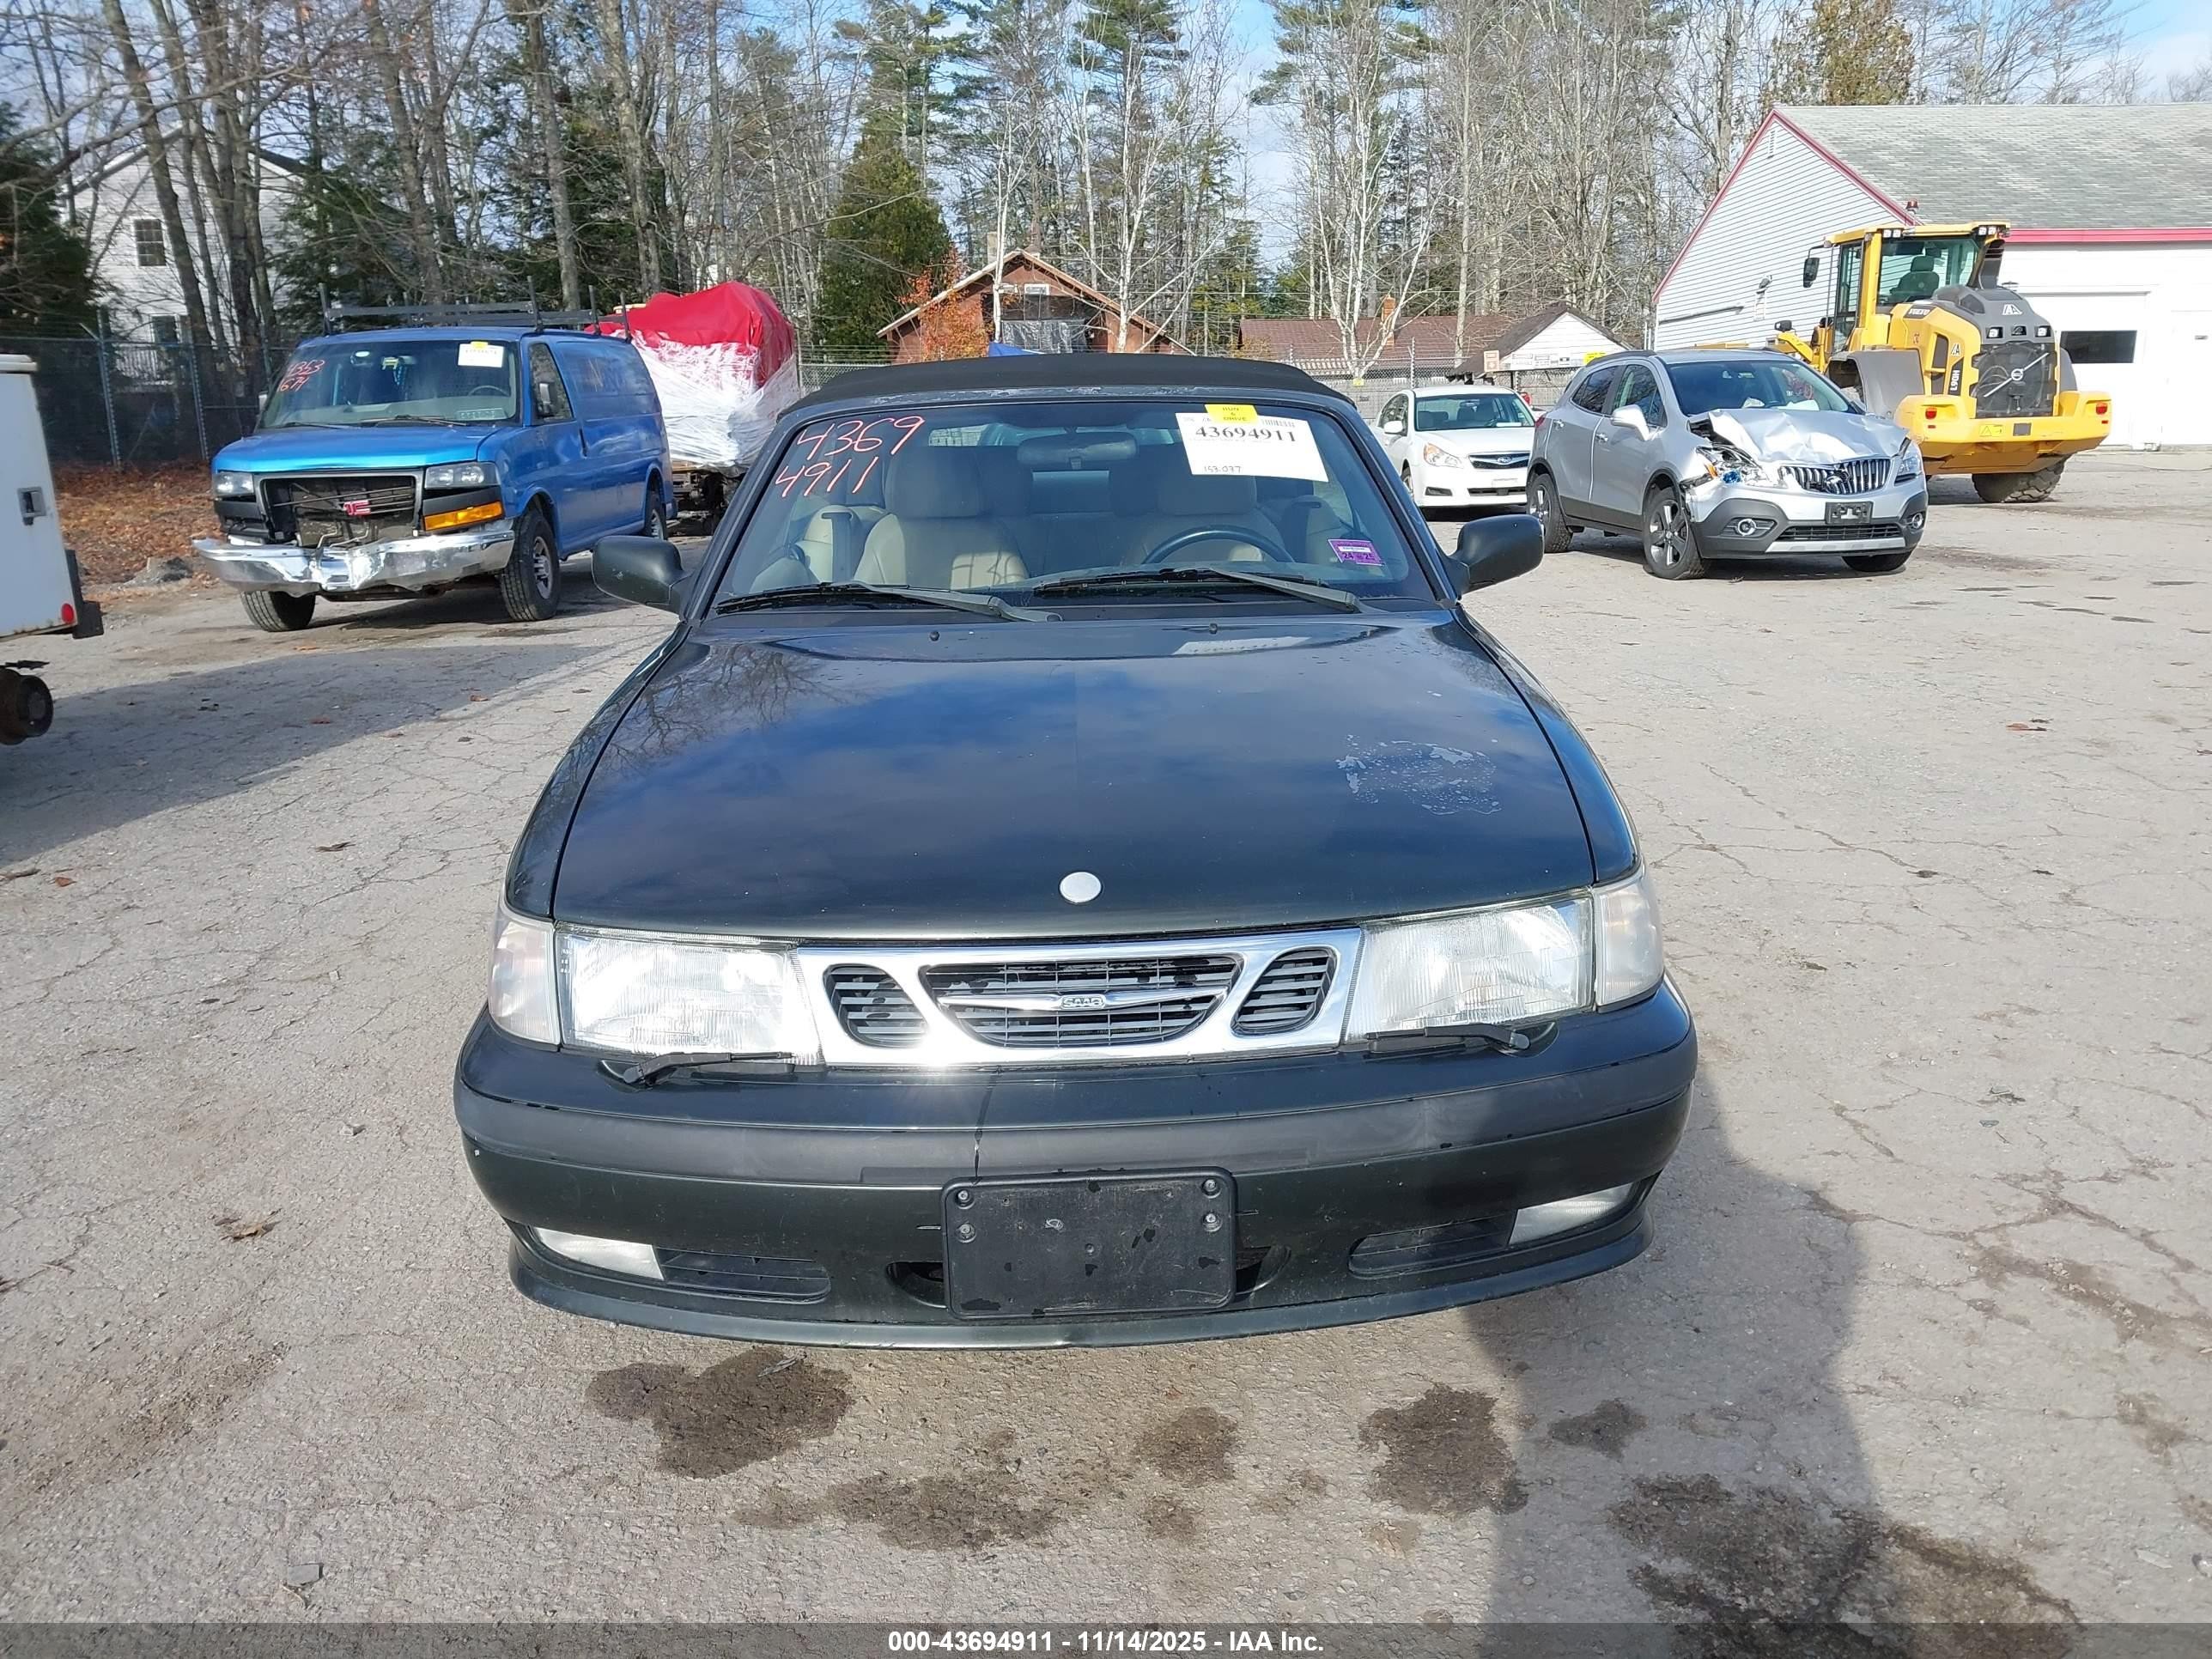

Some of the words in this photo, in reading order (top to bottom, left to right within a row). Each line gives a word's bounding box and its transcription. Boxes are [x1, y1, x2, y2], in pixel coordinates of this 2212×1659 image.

[1949, 369, 1961, 392] L90H
[796, 415, 926, 461] 4369
[1194, 426, 1297, 442] 43694911
[775, 456, 879, 498] 4911
